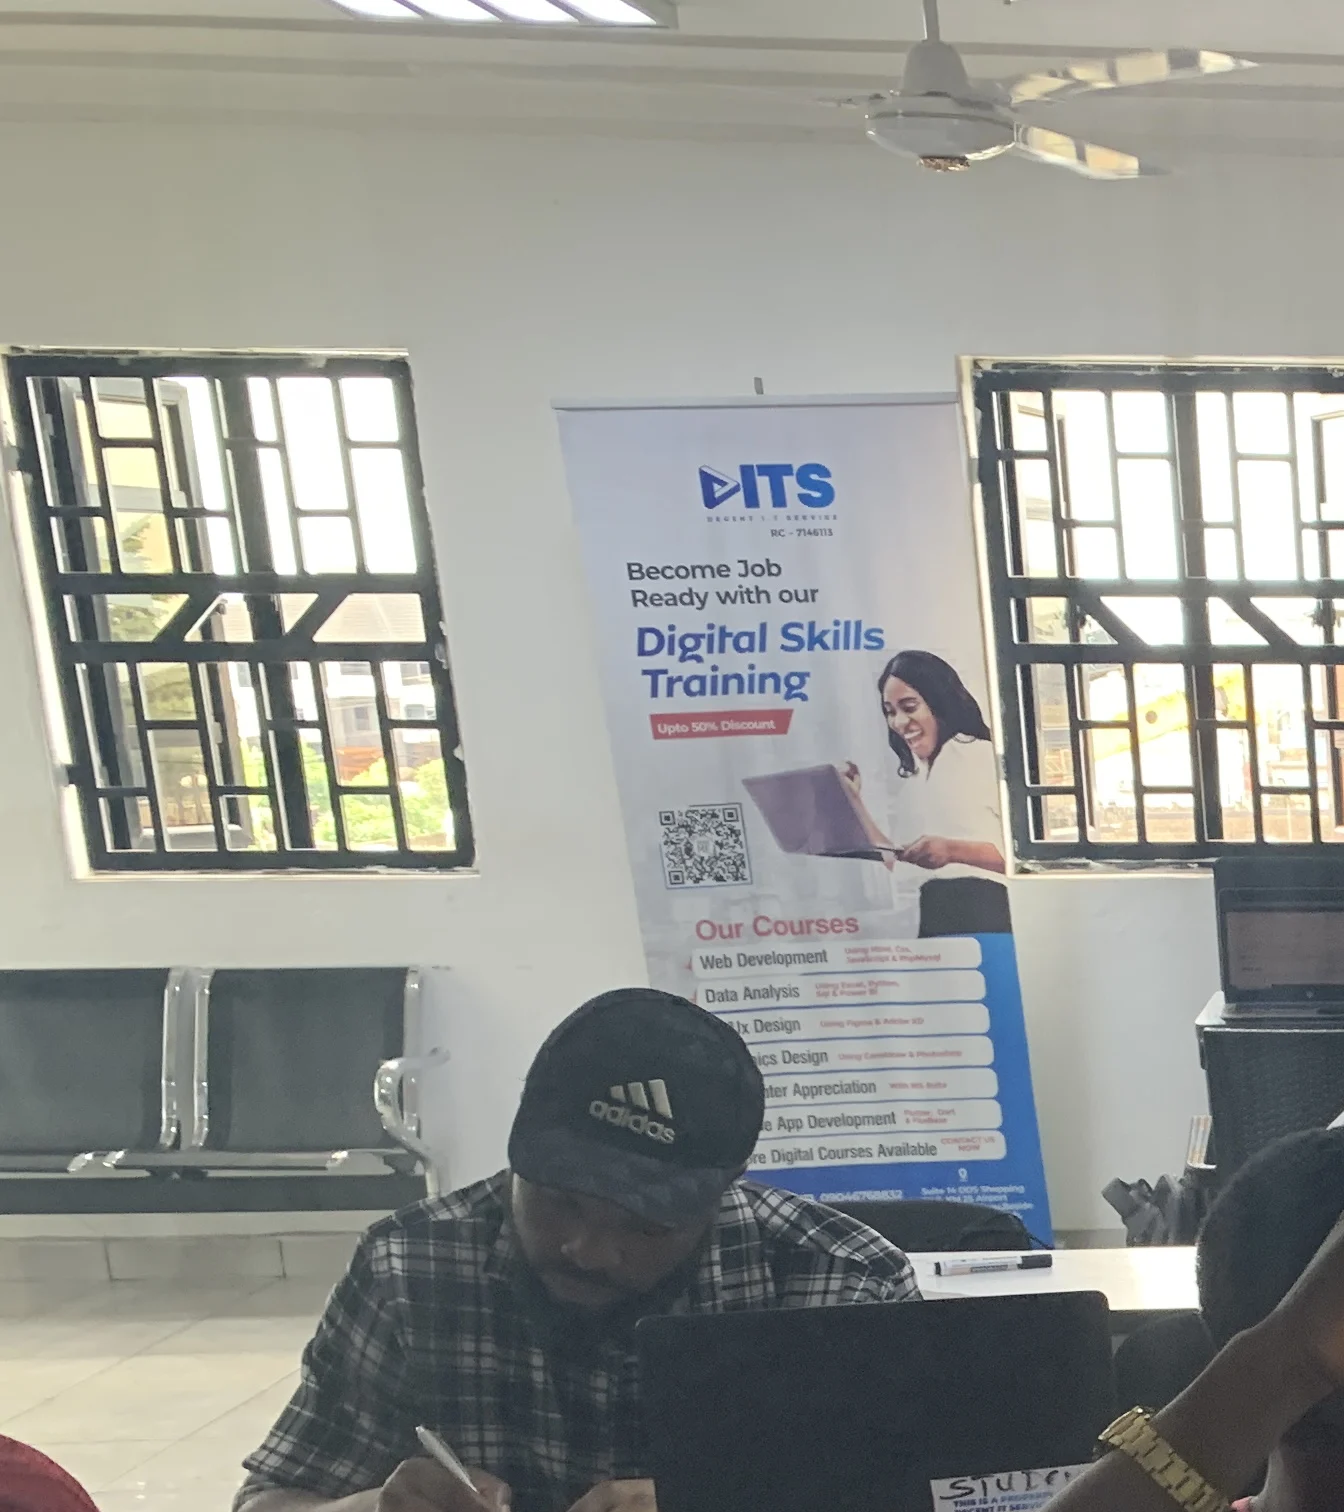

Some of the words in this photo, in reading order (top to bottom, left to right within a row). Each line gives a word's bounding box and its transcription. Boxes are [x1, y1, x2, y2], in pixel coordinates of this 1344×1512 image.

[626, 562, 732, 581] Become
[737, 558, 783, 578] Job
[630, 587, 709, 610] Ready
[715, 585, 772, 605] with
[777, 587, 819, 604] our
[636, 621, 768, 663] Digital
[780, 619, 886, 653] Skills
[641, 663, 811, 702] Training
[657, 722, 689, 736] Upto
[691, 720, 718, 733] 50%
[721, 719, 777, 732] Discount
[695, 919, 744, 941] Our
[752, 915, 860, 937] Courses
[699, 954, 732, 970] Web
[737, 949, 828, 968] Development
[705, 987, 739, 1003] Data
[743, 984, 800, 1003] Analysis
[754, 1018, 801, 1035] Design
[782, 1050, 828, 1067] Design
[793, 1080, 876, 1100] Appreciation
[777, 1115, 803, 1131] App
[808, 1111, 896, 1129] Development
[771, 1147, 813, 1164] Digital
[818, 1144, 873, 1161] Courses
[877, 1141, 937, 1158] Available
